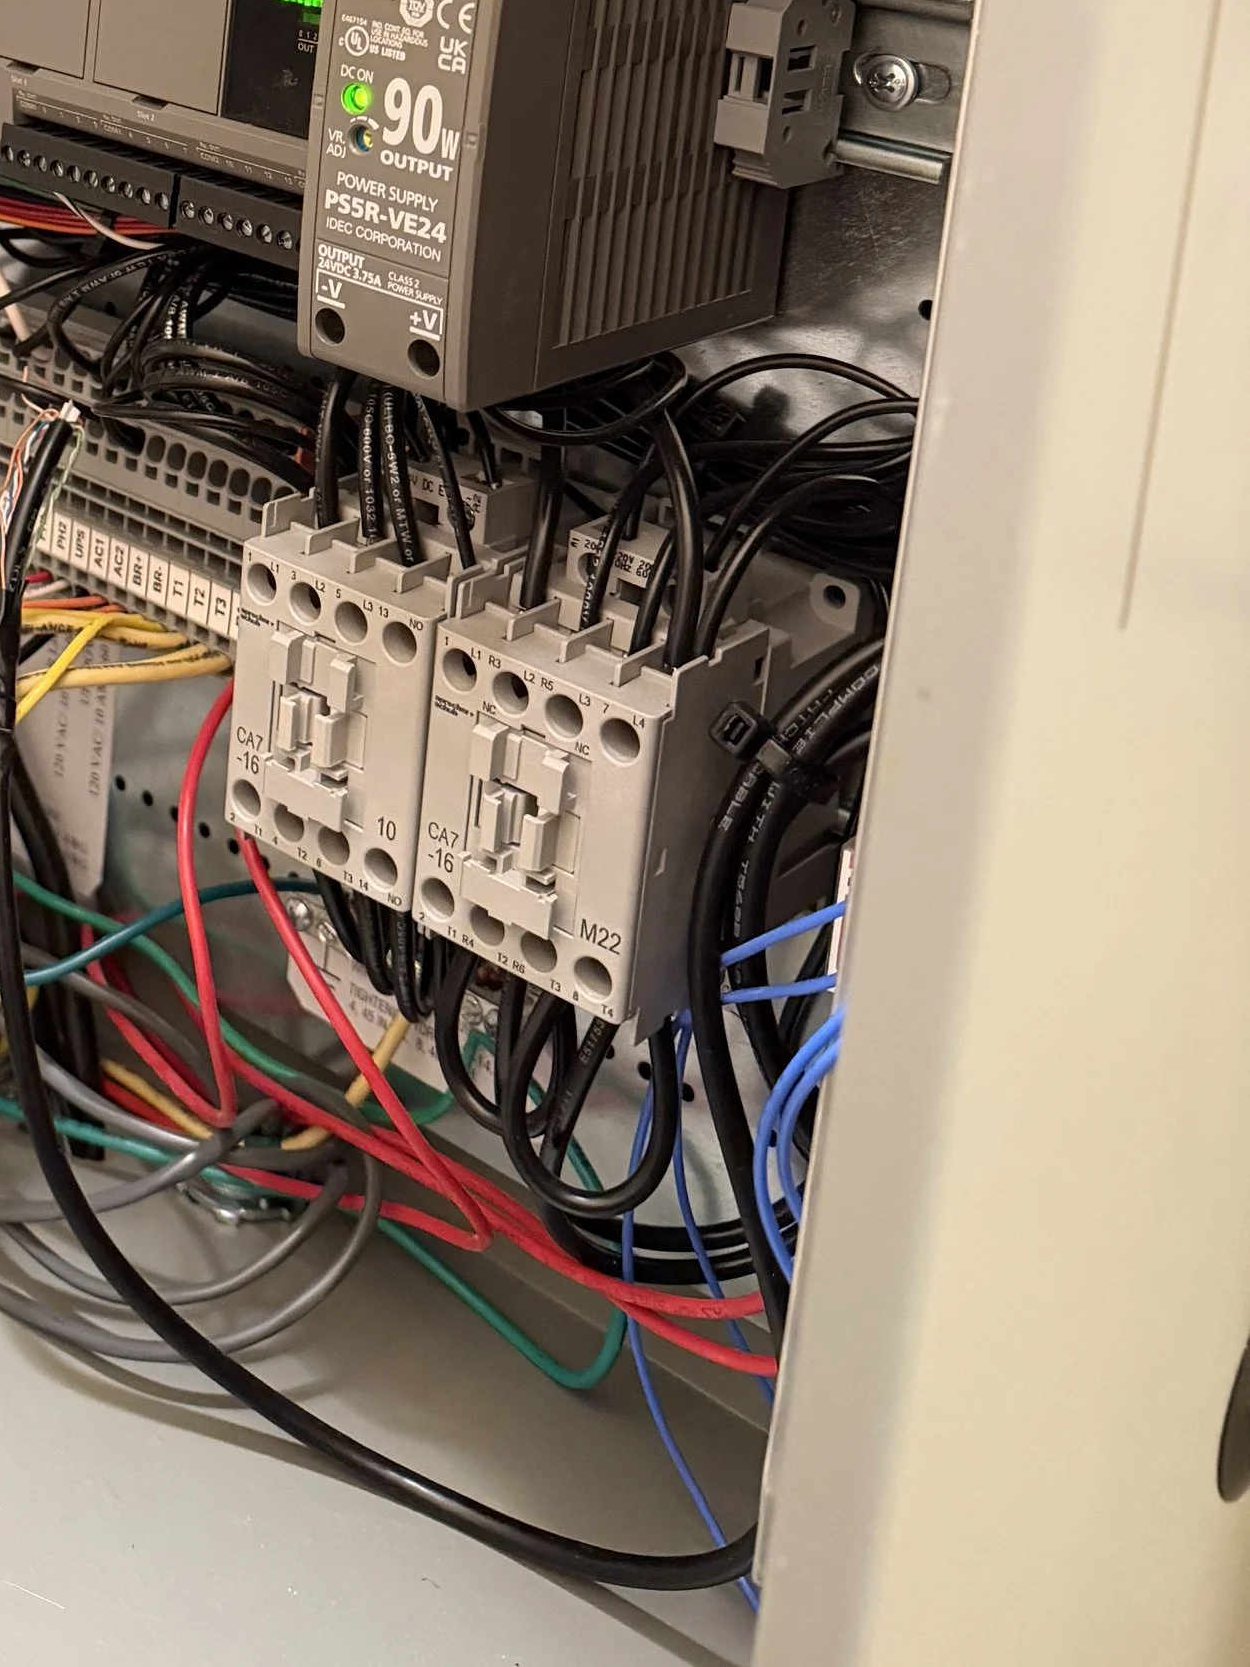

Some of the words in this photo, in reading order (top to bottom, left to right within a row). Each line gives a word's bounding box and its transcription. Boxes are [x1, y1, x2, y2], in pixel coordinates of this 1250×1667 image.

[297, 42, 314, 54] OUT
[350, 31, 363, 50] UL
[440, 36, 468, 58] UK
[381, 47, 406, 61] LISTED
[438, 53, 466, 74] CA
[341, 64, 356, 79] DC
[357, 68, 374, 83] ON
[328, 128, 346, 144] VR.
[325, 143, 347, 159] ADJ
[380, 149, 454, 182] OUTPUT
[337, 171, 386, 199] POWER
[389, 186, 439, 213] SUPPLY
[324, 188, 448, 244] PS5R-VE24
[326, 216, 353, 236] IDEC
[355, 225, 442, 263] CORPORATION
[318, 244, 365, 269] OUTPUT
[318, 256, 352, 279] 24VDC
[352, 267, 382, 288] 3.75A
[387, 271, 413, 286] CLASS
[414, 279, 420, 288] 2
[321, 279, 343, 300] -V
[387, 282, 414, 297] POWER
[415, 288, 443, 306] SUPPLY
[410, 308, 438, 331] +V
[58, 520, 68, 550] PH2
[75, 529, 85, 558] UPS
[94, 539, 105, 568] AC1
[114, 546, 125, 578] AC2
[133, 555, 145, 586] BR+
[154, 565, 164, 593] BR-
[173, 579, 184, 598] T1
[194, 587, 205, 607] T2
[270, 562, 280, 573] L1
[291, 571, 297, 580] 3
[315, 580, 325, 592] L2
[336, 589, 341, 599] 5
[363, 599, 373, 612] L3
[379, 606, 389, 618] 13
[409, 618, 424, 631] NO
[214, 596, 226, 617] T3
[444, 636, 449, 646] 1
[471, 647, 481, 660] L1
[488, 655, 501, 669] R3
[523, 670, 535, 684] L2
[541, 677, 554, 691] R5
[579, 693, 591, 706] L3
[603, 703, 610, 714] 7
[632, 715, 645, 729] L4
[482, 700, 496, 715] NC
[237, 726, 263, 752] CA7
[575, 741, 590, 756] NC
[237, 751, 260, 774] -16
[377, 816, 396, 841] 10
[428, 822, 459, 849] CA7
[230, 812, 236, 821] 2
[254, 824, 263, 836] T1
[272, 836, 278, 845] 4
[297, 847, 308, 860] T2
[343, 870, 353, 884] T3
[359, 879, 369, 891] 14
[387, 893, 402, 906] NO
[428, 849, 454, 873] -16
[580, 919, 622, 955] M22
[419, 912, 425, 921] 2
[447, 926, 456, 938] T1
[462, 935, 474, 948] R4
[497, 952, 508, 966] T2
[512, 961, 525, 974] R6
[550, 979, 561, 992] T3
[572, 991, 579, 1001] 8
[600, 1003, 614, 1018] T4
